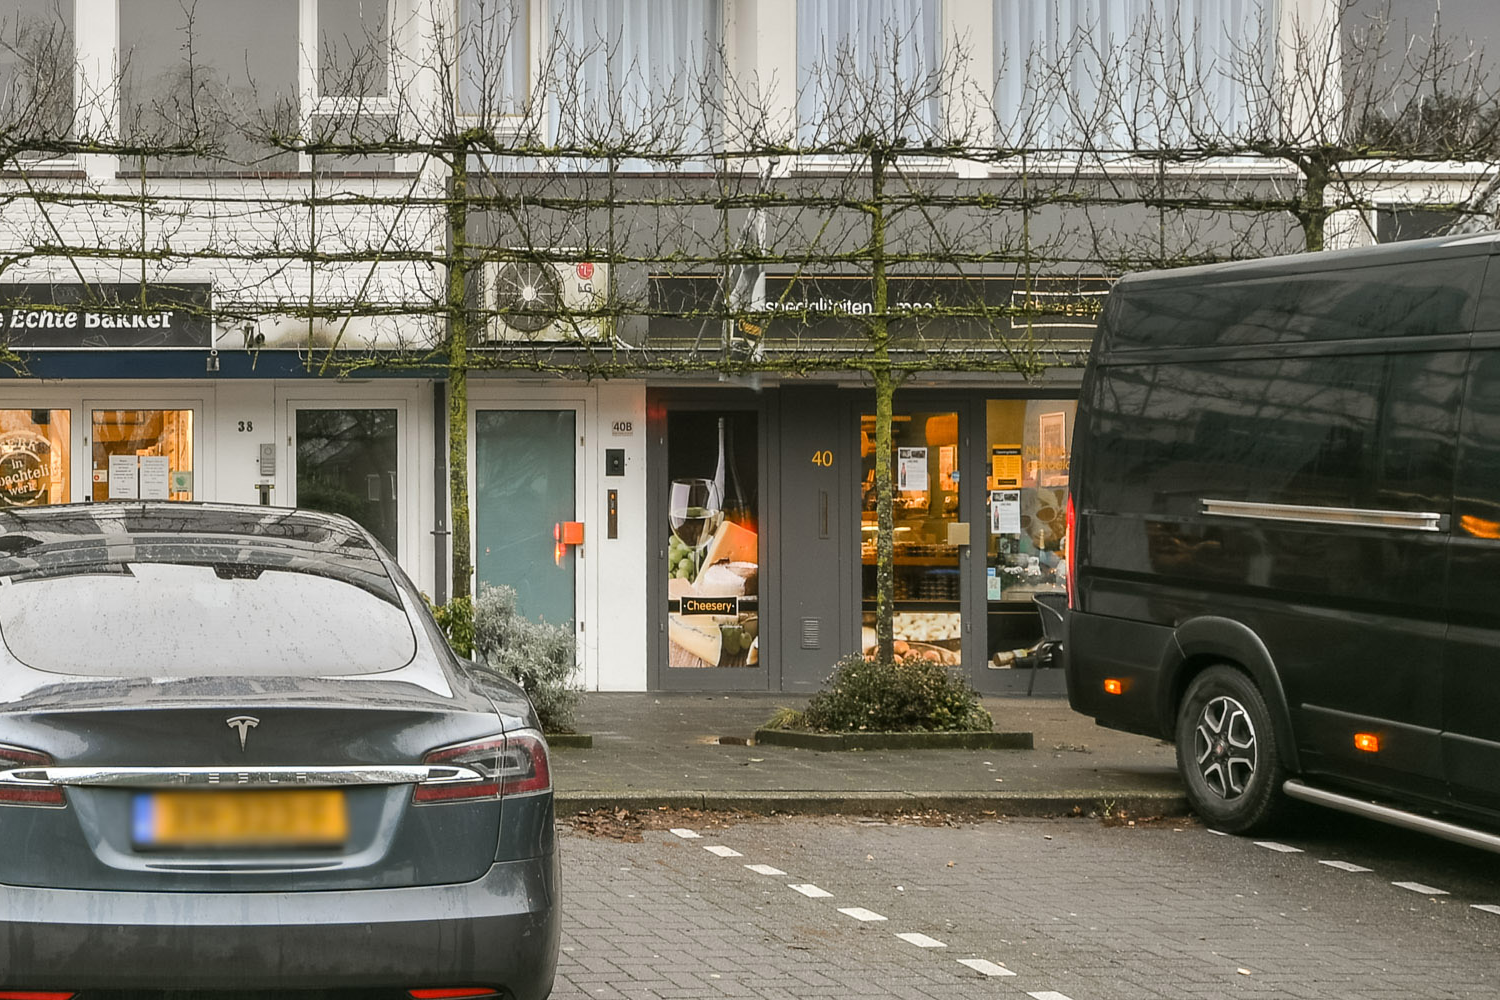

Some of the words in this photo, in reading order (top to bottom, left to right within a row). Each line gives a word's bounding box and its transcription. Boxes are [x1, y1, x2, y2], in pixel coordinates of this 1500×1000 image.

[578, 283, 592, 294] LG
[10, 306, 77, 329] Echte
[85, 307, 173, 329] Bakker
[238, 421, 253, 432] 38
[613, 421, 633, 432] 40B
[811, 450, 833, 467] 40
[687, 600, 732, 613] Cheesery
[179, 772, 307, 784] TESLA
